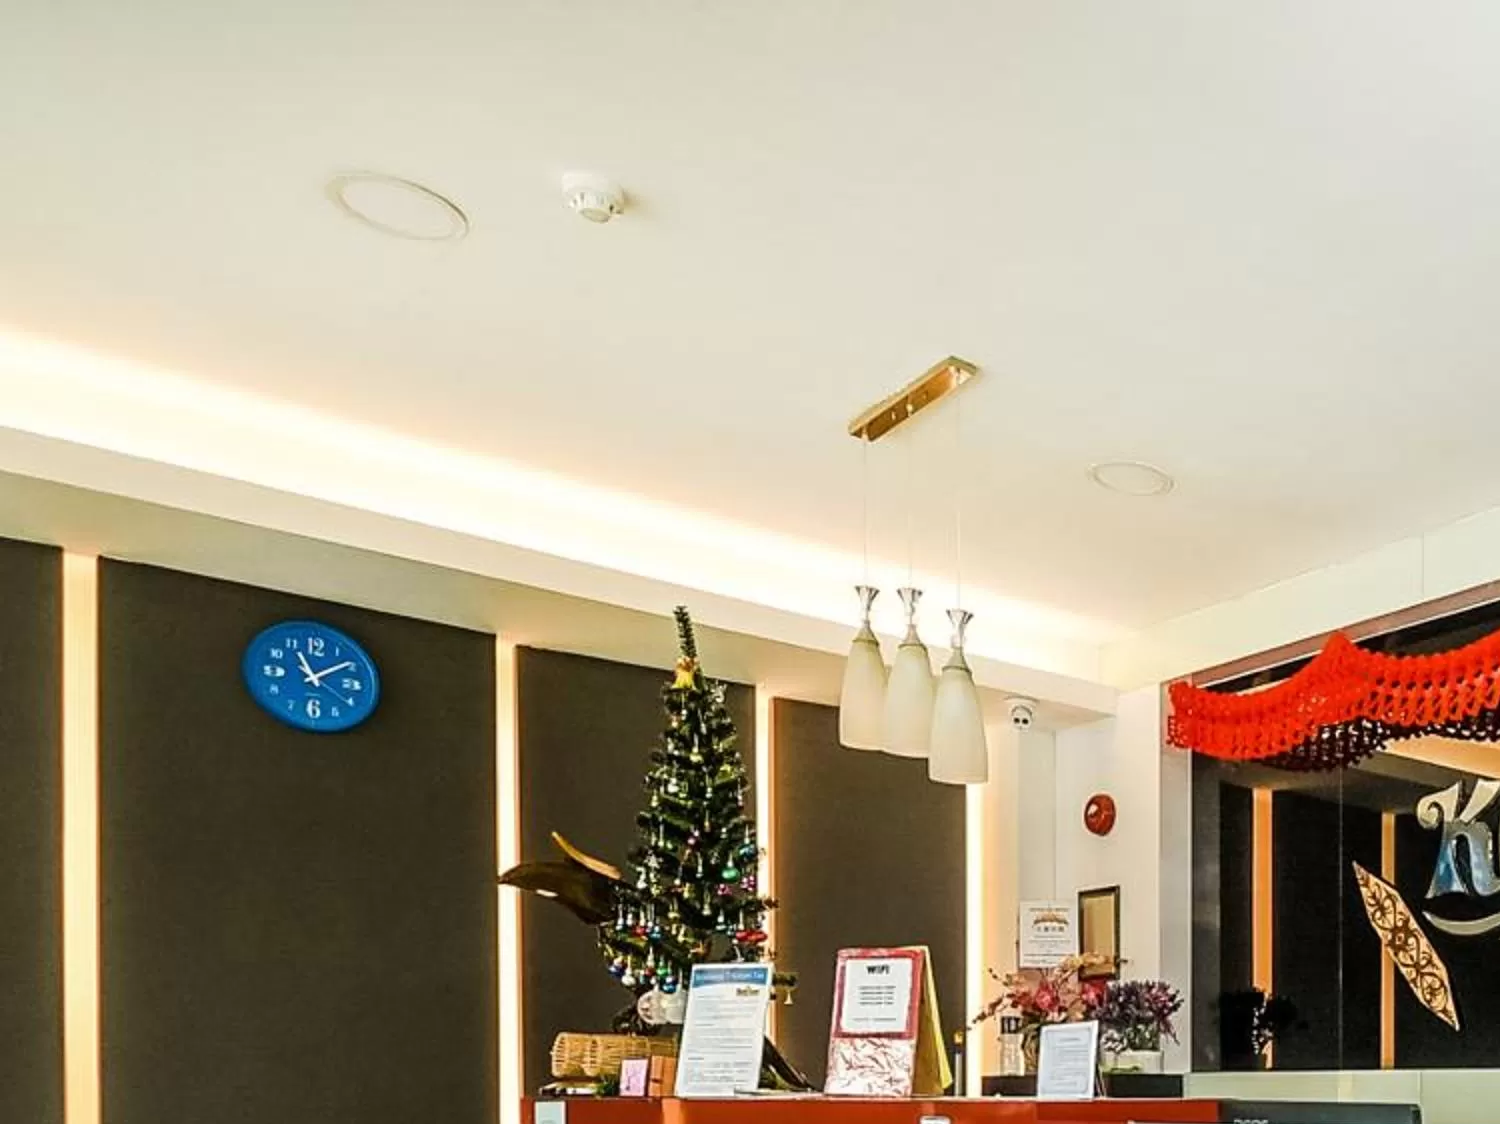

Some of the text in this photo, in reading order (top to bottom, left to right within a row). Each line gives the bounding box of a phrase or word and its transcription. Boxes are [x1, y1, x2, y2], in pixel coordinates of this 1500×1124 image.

[285, 638, 298, 650] 11
[308, 637, 325, 657] 12
[270, 648, 284, 660] 10
[305, 699, 322, 719] 6
